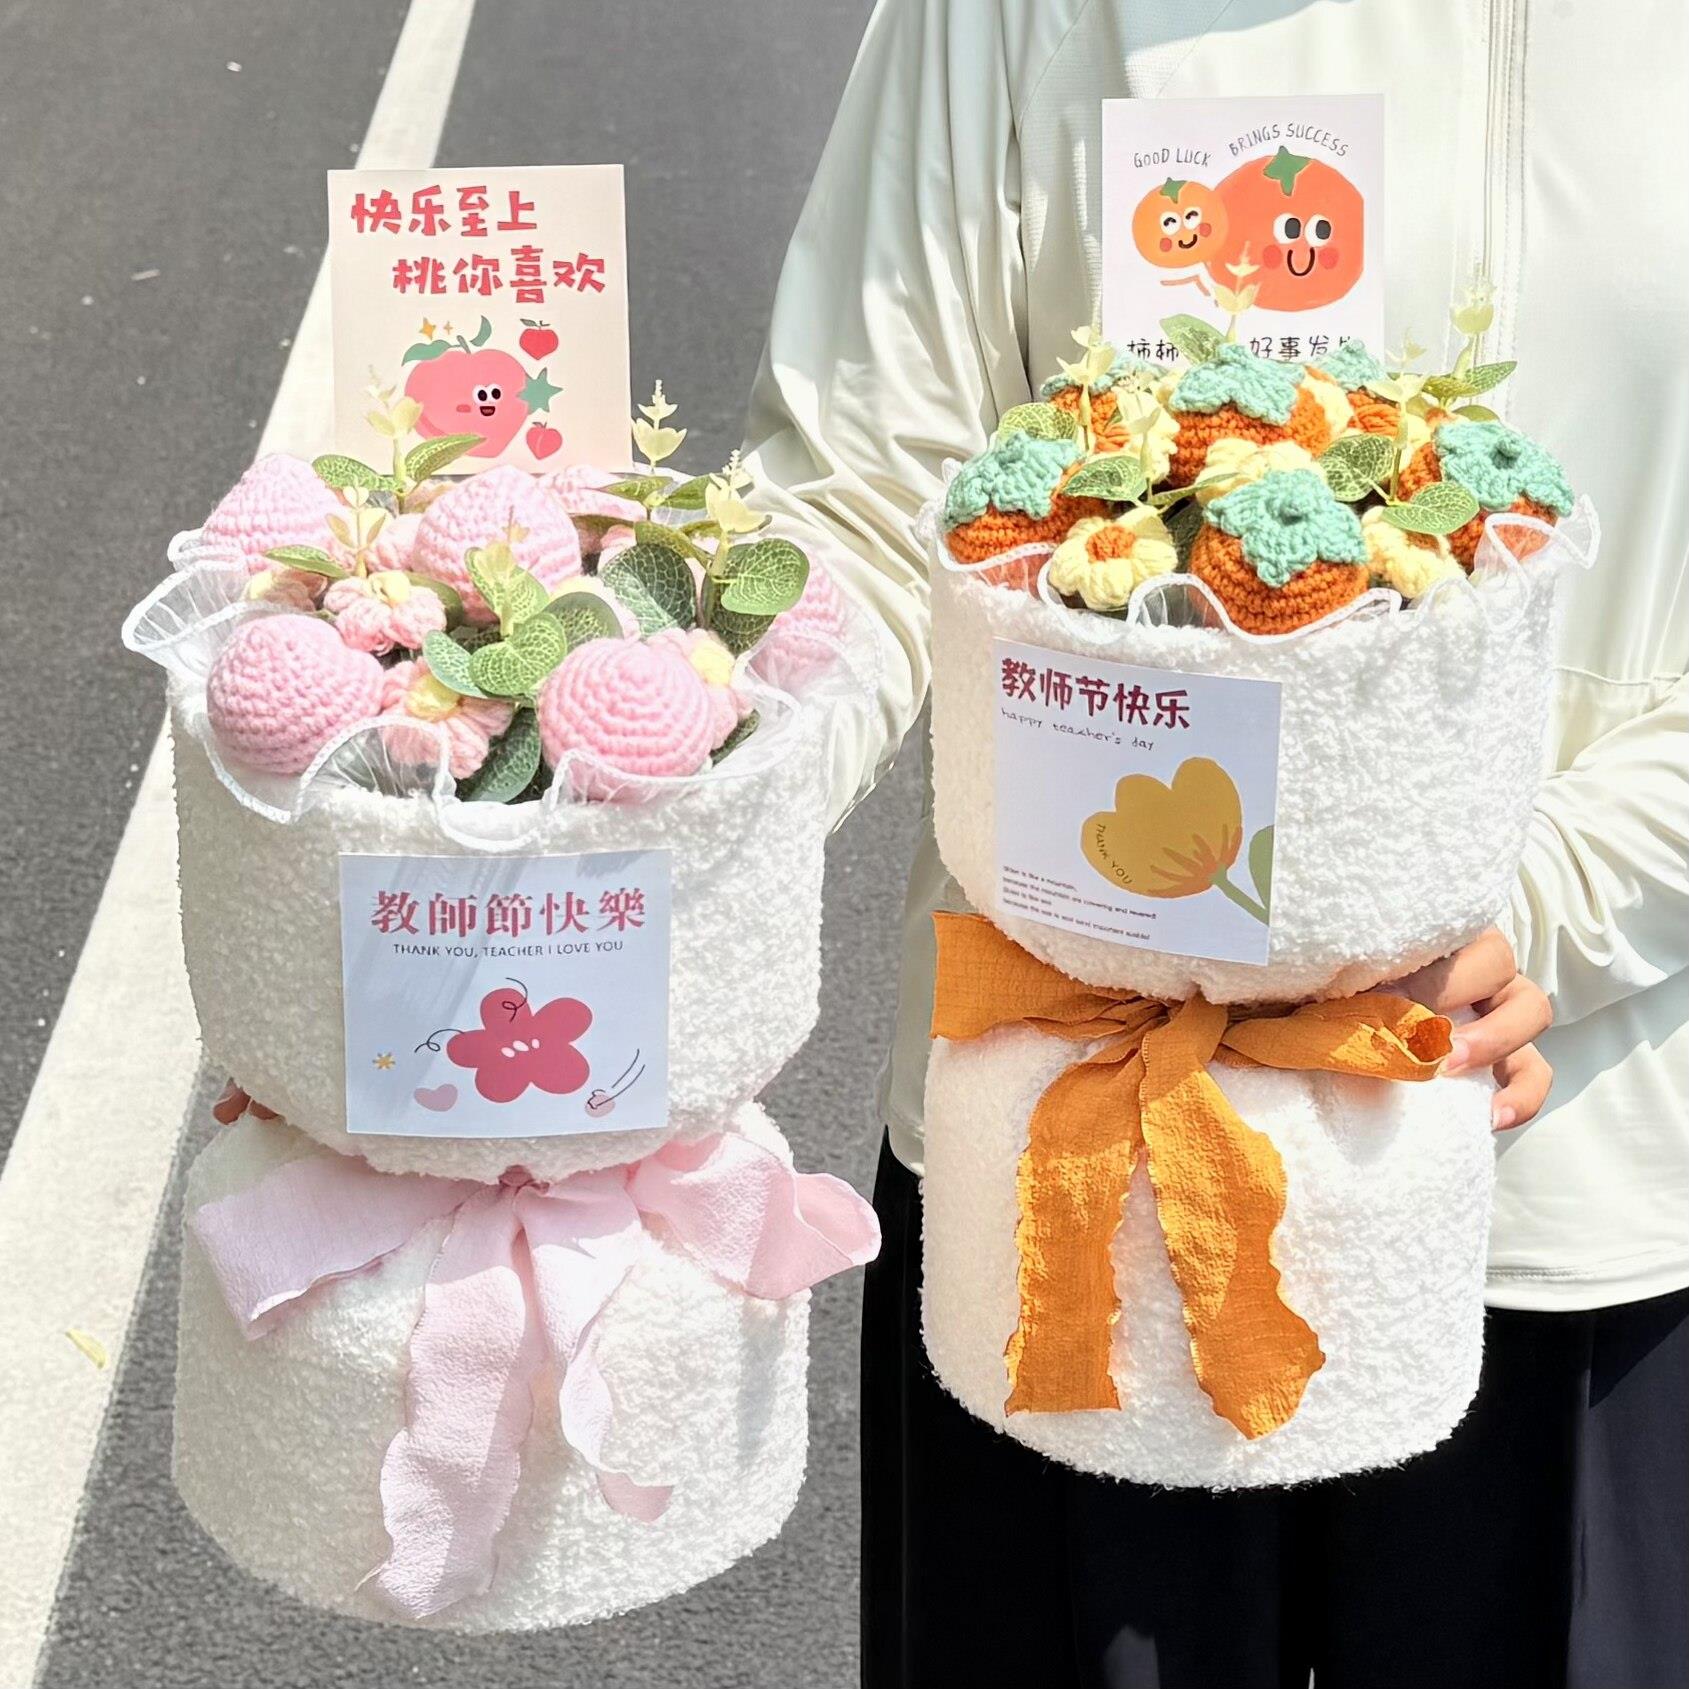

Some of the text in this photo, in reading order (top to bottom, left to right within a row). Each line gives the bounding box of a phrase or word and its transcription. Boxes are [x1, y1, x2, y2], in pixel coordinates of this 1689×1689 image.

[1133, 148, 1213, 168] GOOD LUCK
[1228, 122, 1349, 157] BRINGS SUCCESS
[350, 184, 538, 236] 快乐至上
[392, 245, 606, 303] 桃你喜欢
[1001, 657, 1190, 729] 教师节快乐
[1001, 707, 1154, 750] happy teacher's day
[1112, 860, 1132, 884] YOU
[371, 887, 646, 937] 教師節快樂
[394, 943, 440, 956] THANK
[446, 944, 478, 958] YOU,
[483, 945, 544, 957] TEACHER
[557, 942, 589, 955] LOVE
[596, 941, 623, 952] YOU
